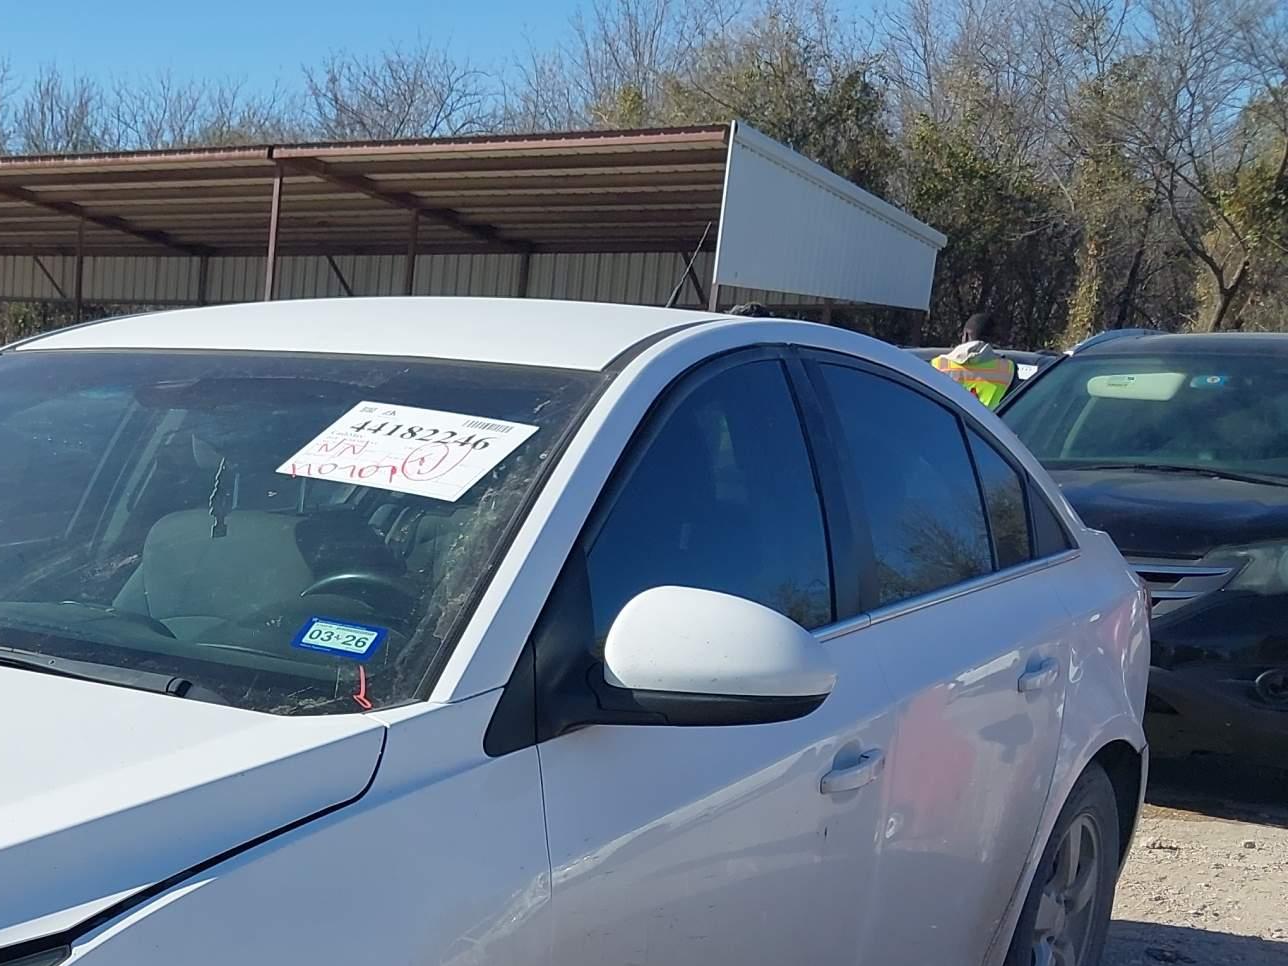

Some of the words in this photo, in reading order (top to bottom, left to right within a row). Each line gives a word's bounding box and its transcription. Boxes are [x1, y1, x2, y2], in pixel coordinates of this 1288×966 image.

[350, 420, 498, 451] 44182246
[308, 629, 335, 642] 03
[341, 634, 369, 648] 26
